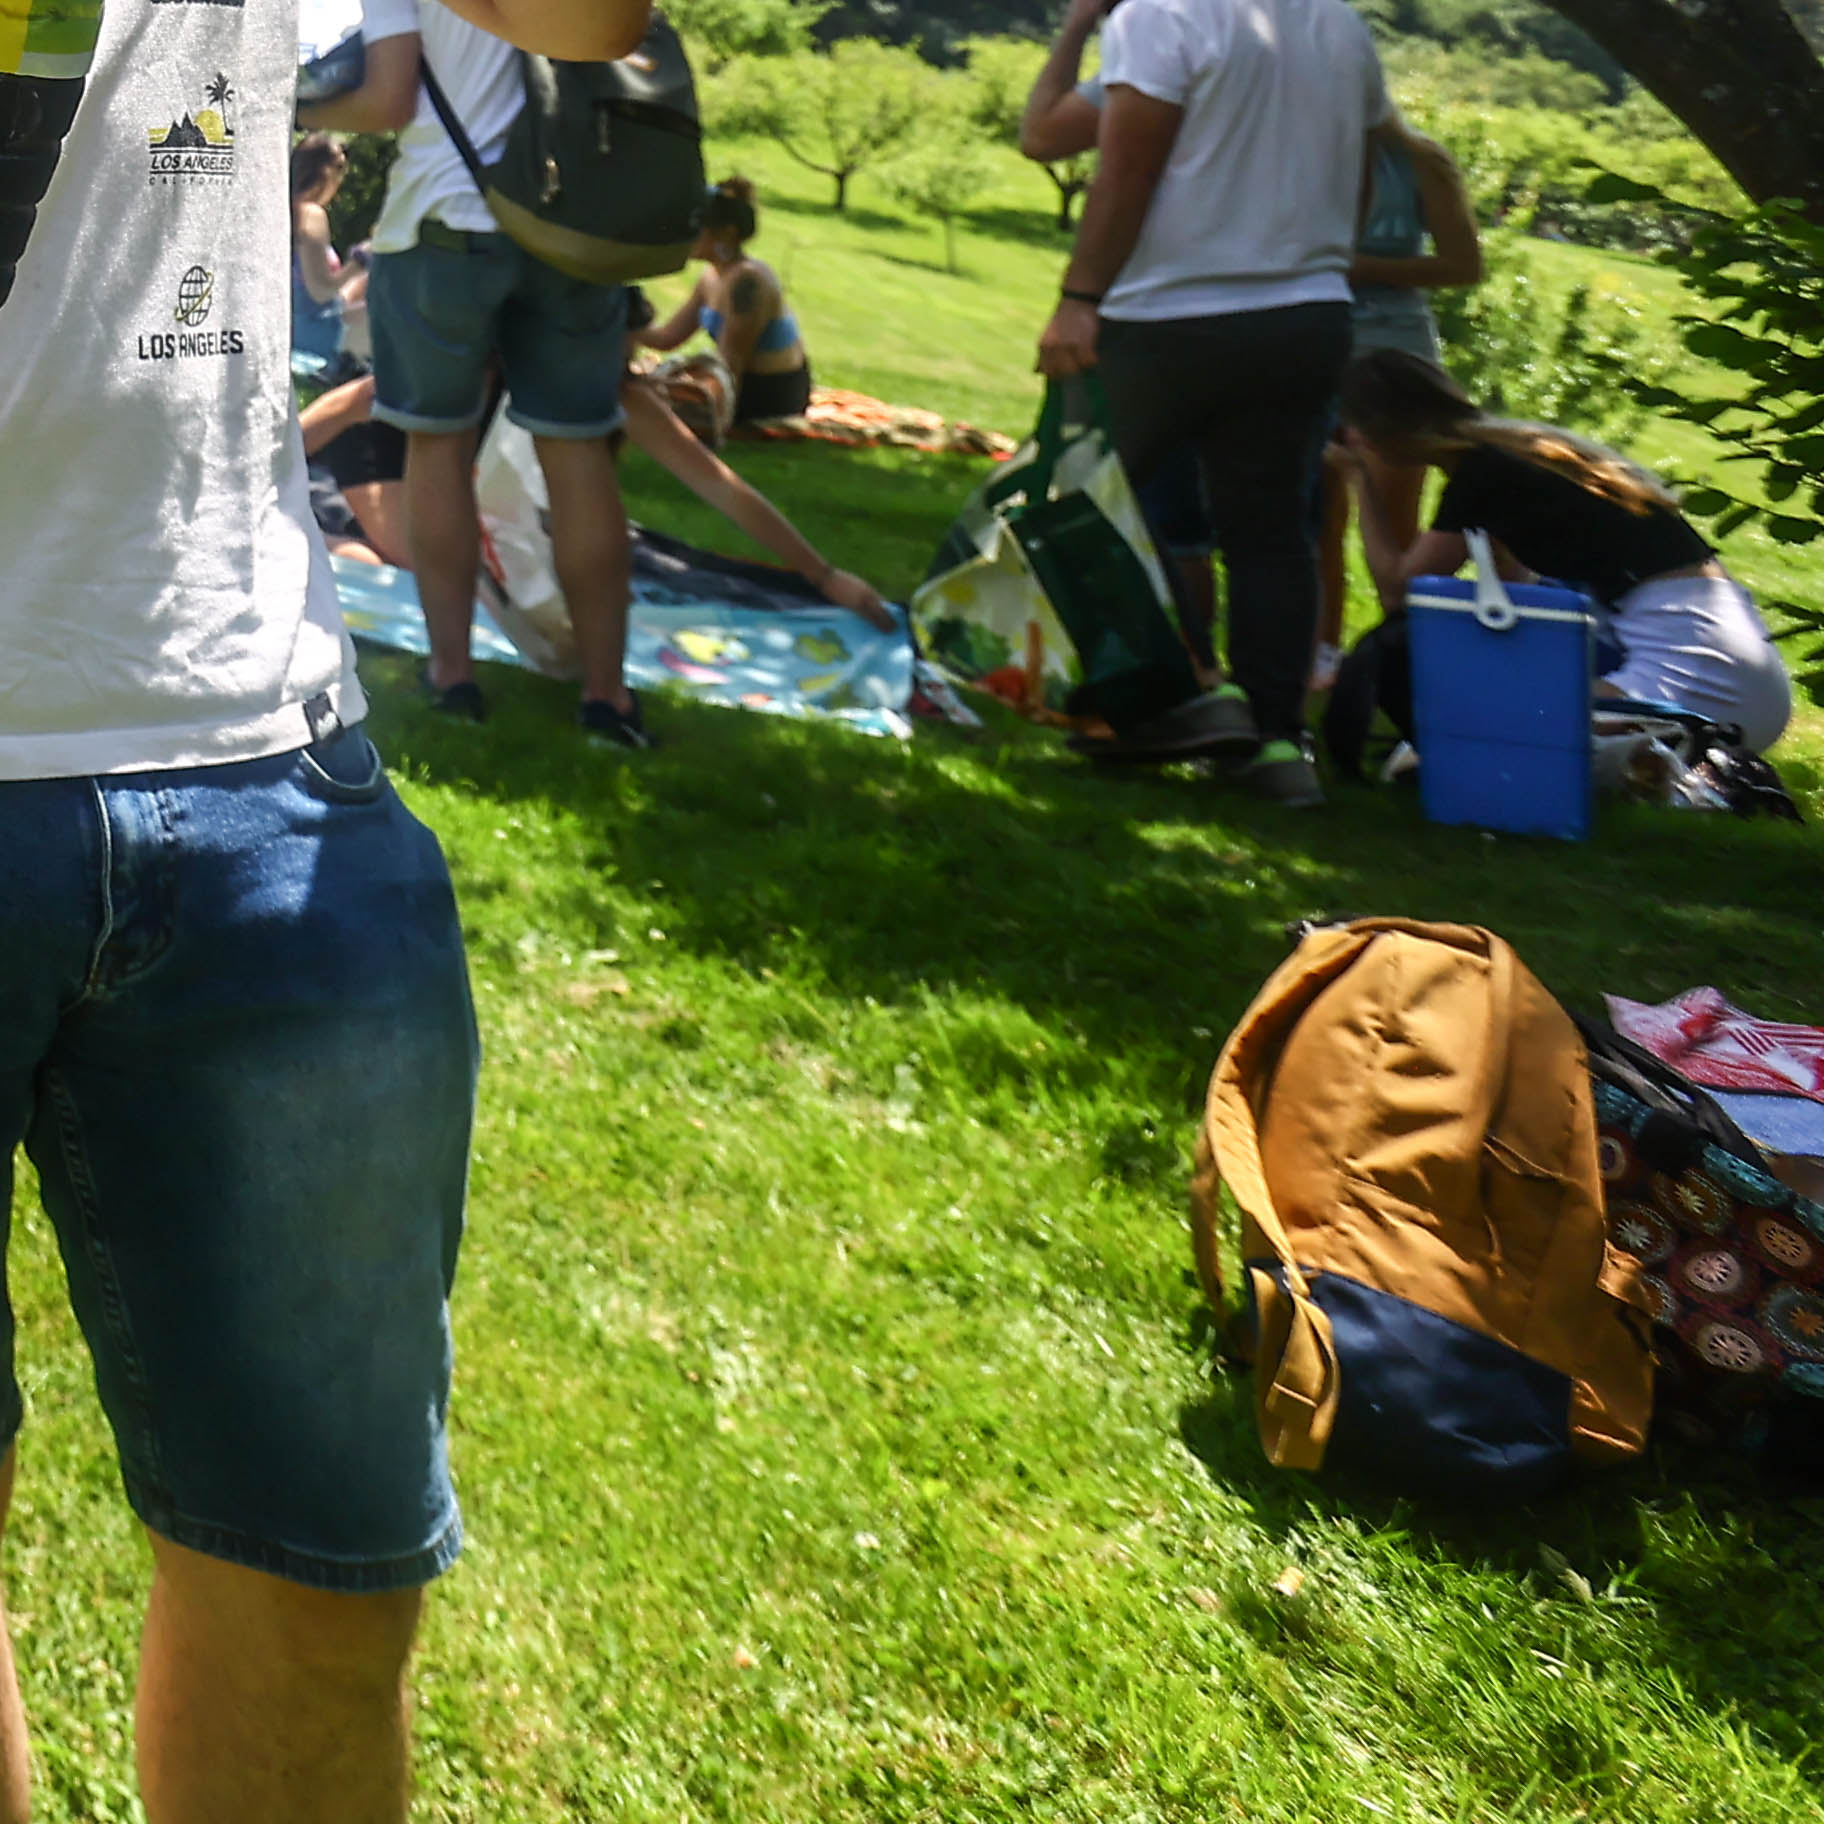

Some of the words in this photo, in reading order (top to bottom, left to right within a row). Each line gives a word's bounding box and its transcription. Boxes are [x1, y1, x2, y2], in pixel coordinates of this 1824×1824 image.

[151, 155, 181, 170] LOS
[183, 155, 233, 170] ANGELES
[138, 333, 175, 360] LOS
[179, 330, 244, 357] ANGELES
